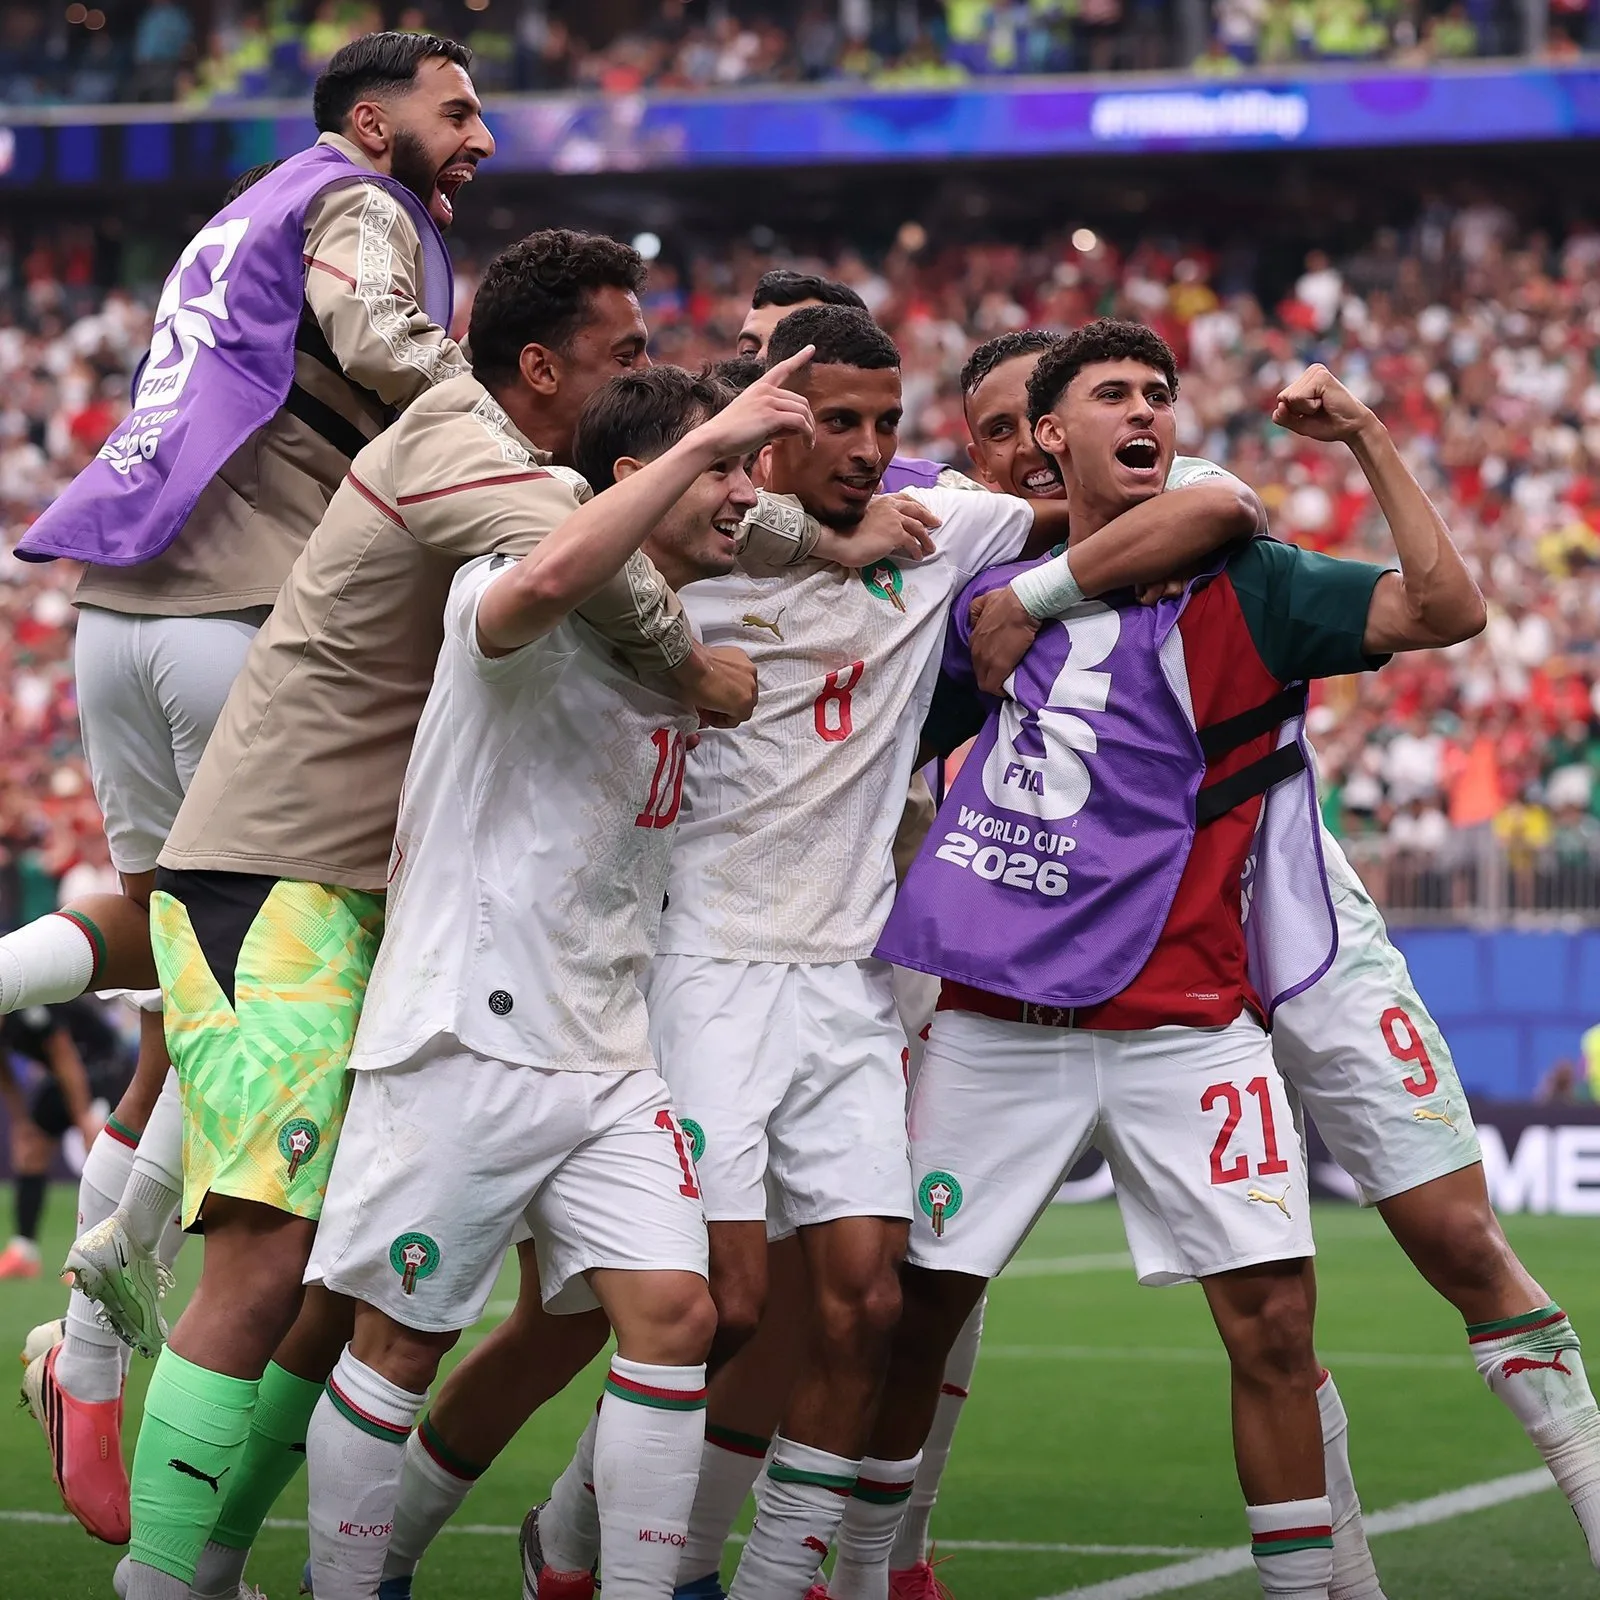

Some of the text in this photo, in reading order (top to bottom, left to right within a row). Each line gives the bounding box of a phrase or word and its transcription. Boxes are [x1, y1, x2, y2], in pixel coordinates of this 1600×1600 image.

[137, 372, 179, 397] FIFA
[140, 408, 179, 428] CUP
[814, 660, 865, 742] 8
[634, 728, 687, 830] 10
[935, 832, 1070, 897] 2026
[957, 804, 1077, 857] WORLD CUP
[1380, 1006, 1438, 1098] 9
[653, 1109, 700, 1200] 1
[1200, 1077, 1289, 1185] 21
